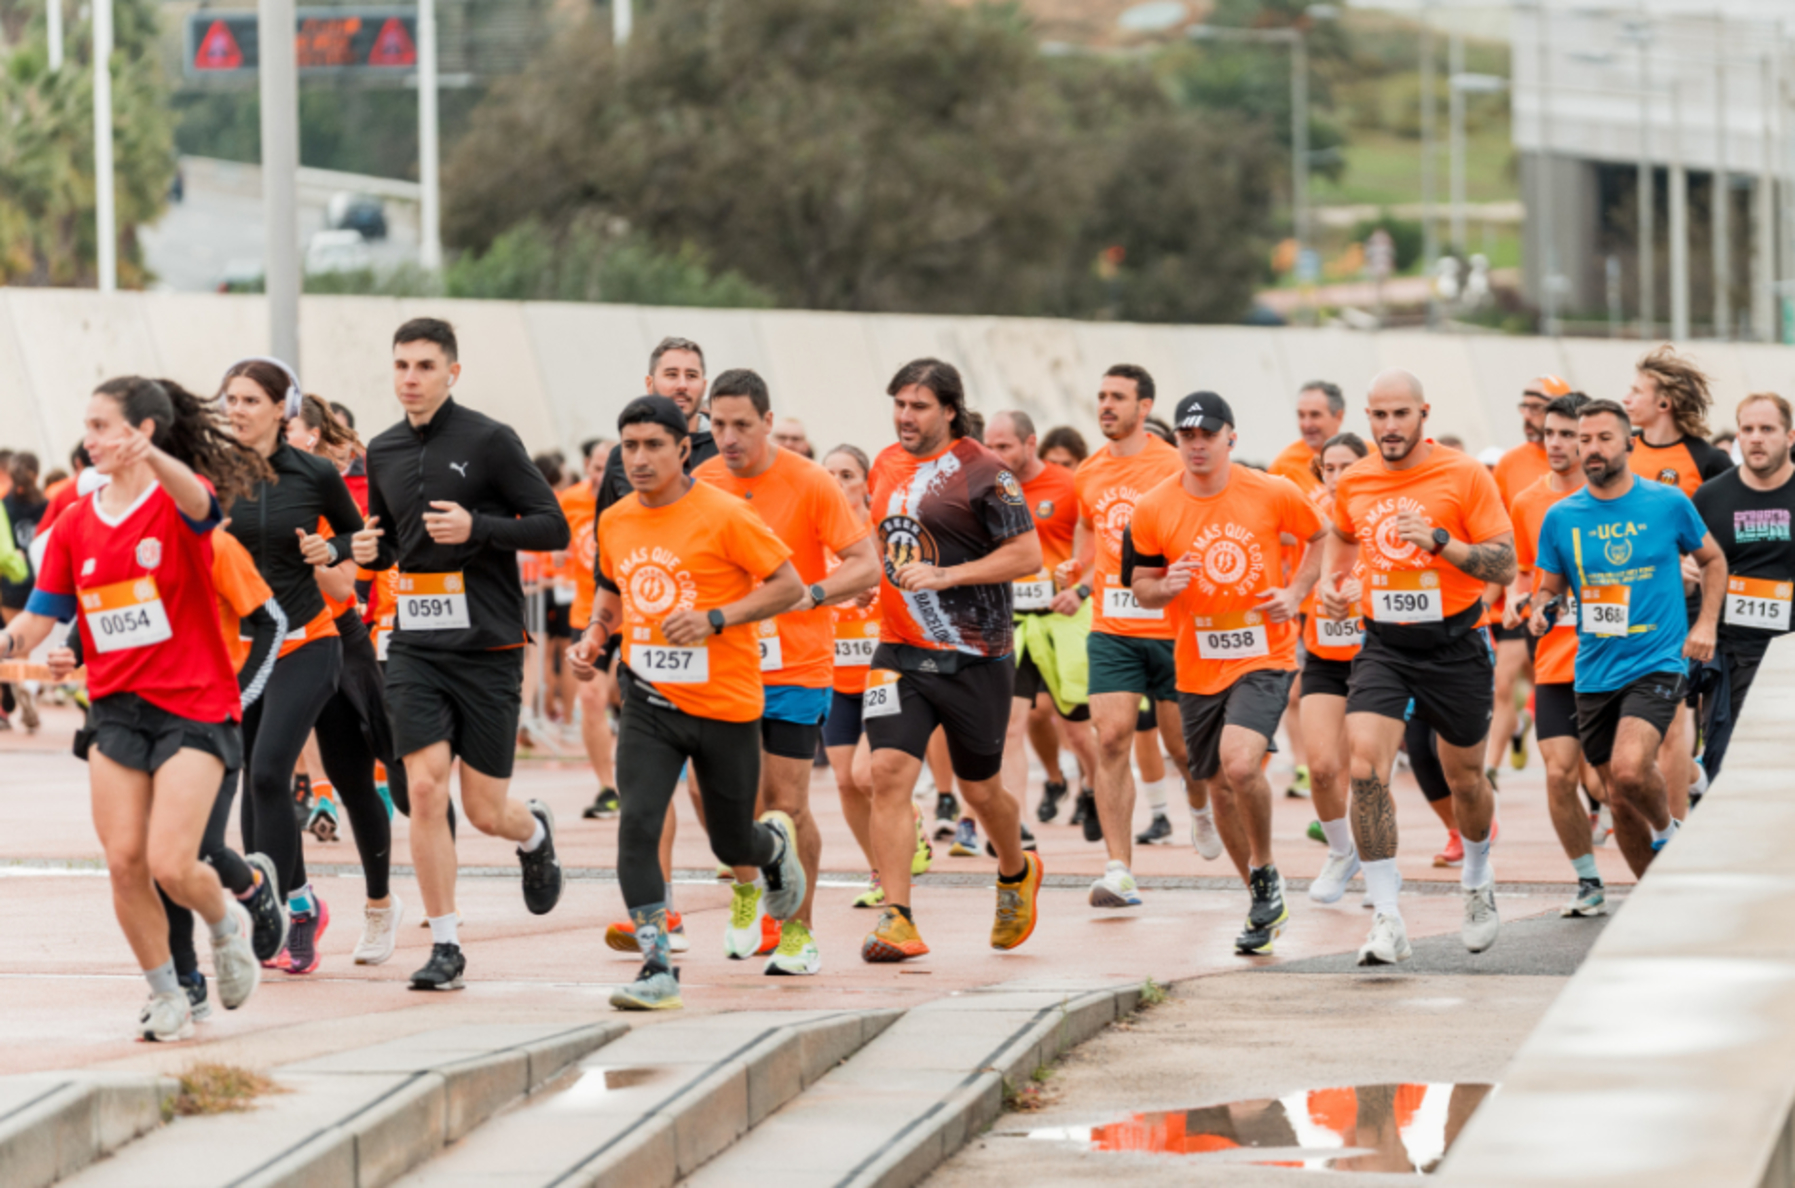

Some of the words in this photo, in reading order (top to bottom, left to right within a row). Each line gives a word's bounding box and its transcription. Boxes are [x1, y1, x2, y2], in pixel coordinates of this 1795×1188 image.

[1366, 499, 1395, 525] MÁS
[884, 517, 920, 535] BEER
[1225, 522, 1255, 546] QUE
[1597, 521, 1638, 539] UCA
[1193, 523, 1222, 551] MÁS
[619, 547, 649, 575] MÁS
[651, 546, 681, 572] QUE
[1234, 543, 1264, 597] CORRER
[1013, 585, 1043, 599] 445
[1111, 592, 1139, 608] 17
[408, 598, 453, 617] 0591
[1383, 593, 1429, 612] 1590
[1735, 599, 1780, 619] 2115
[100, 607, 151, 636] 0054
[1208, 631, 1255, 650] 0538
[643, 650, 693, 671] 1257
